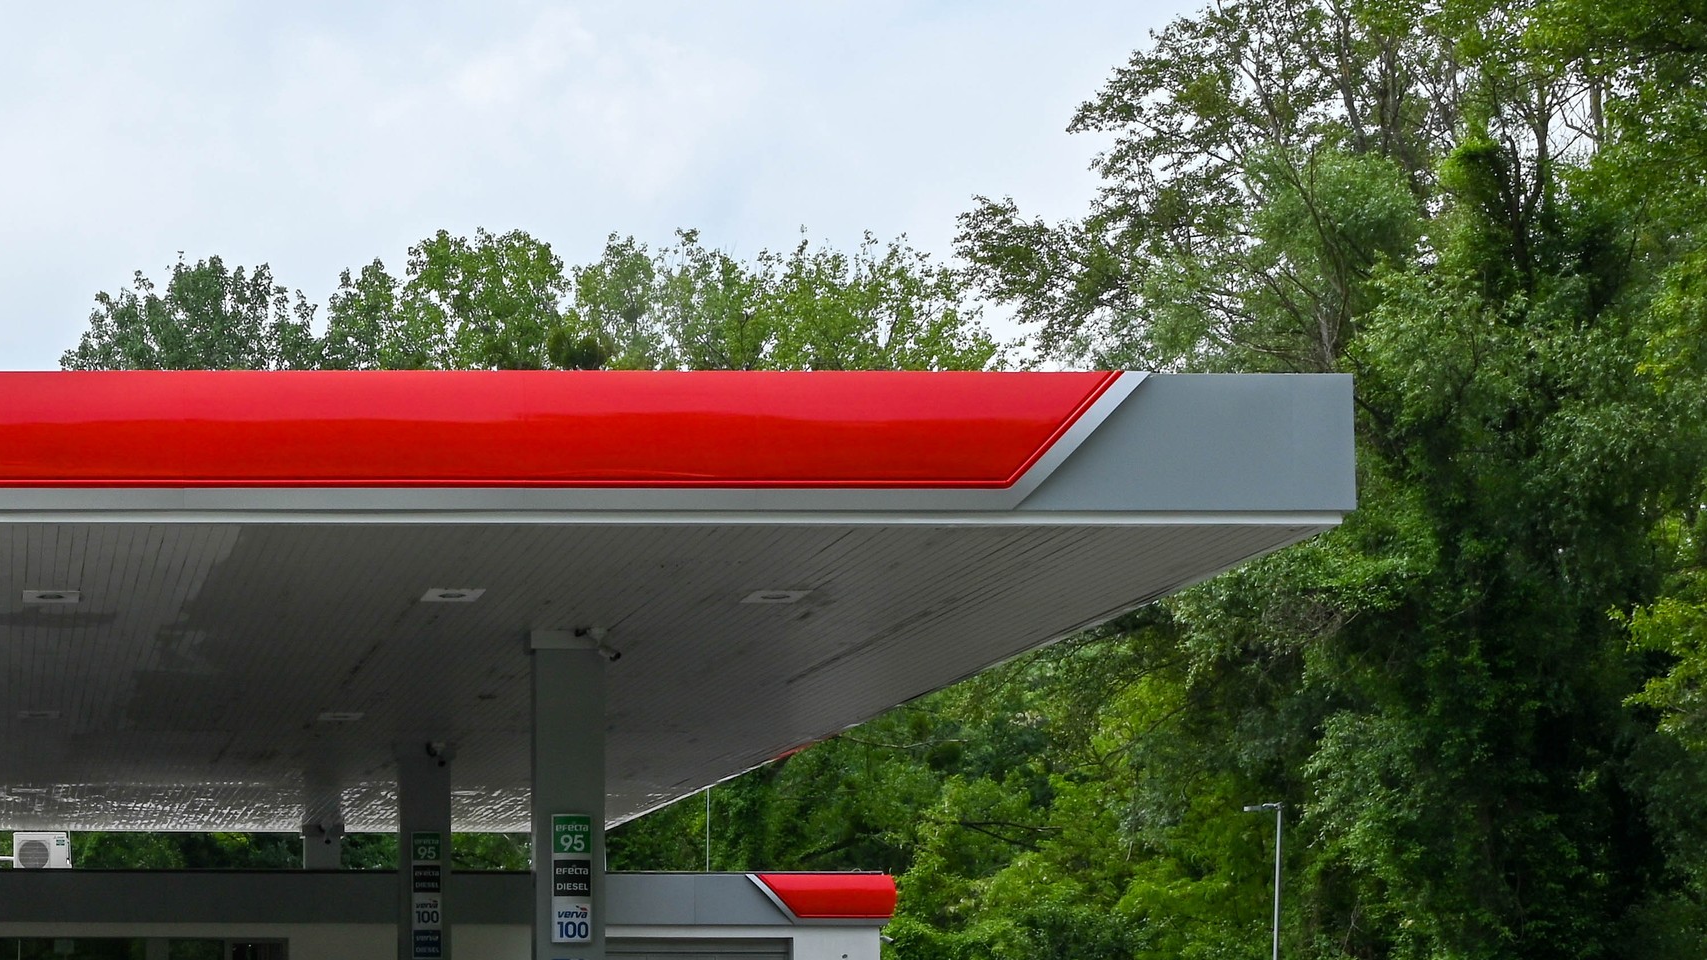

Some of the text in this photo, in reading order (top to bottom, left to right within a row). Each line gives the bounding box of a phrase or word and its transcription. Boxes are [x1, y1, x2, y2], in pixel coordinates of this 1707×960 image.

[555, 823, 589, 832] efecta
[560, 834, 585, 852] 95
[417, 846, 436, 860] 95
[555, 866, 589, 875] efecta
[556, 882, 589, 891] DIESEL
[415, 910, 439, 924] 100
[557, 910, 588, 919] verva
[557, 921, 589, 939] 100
